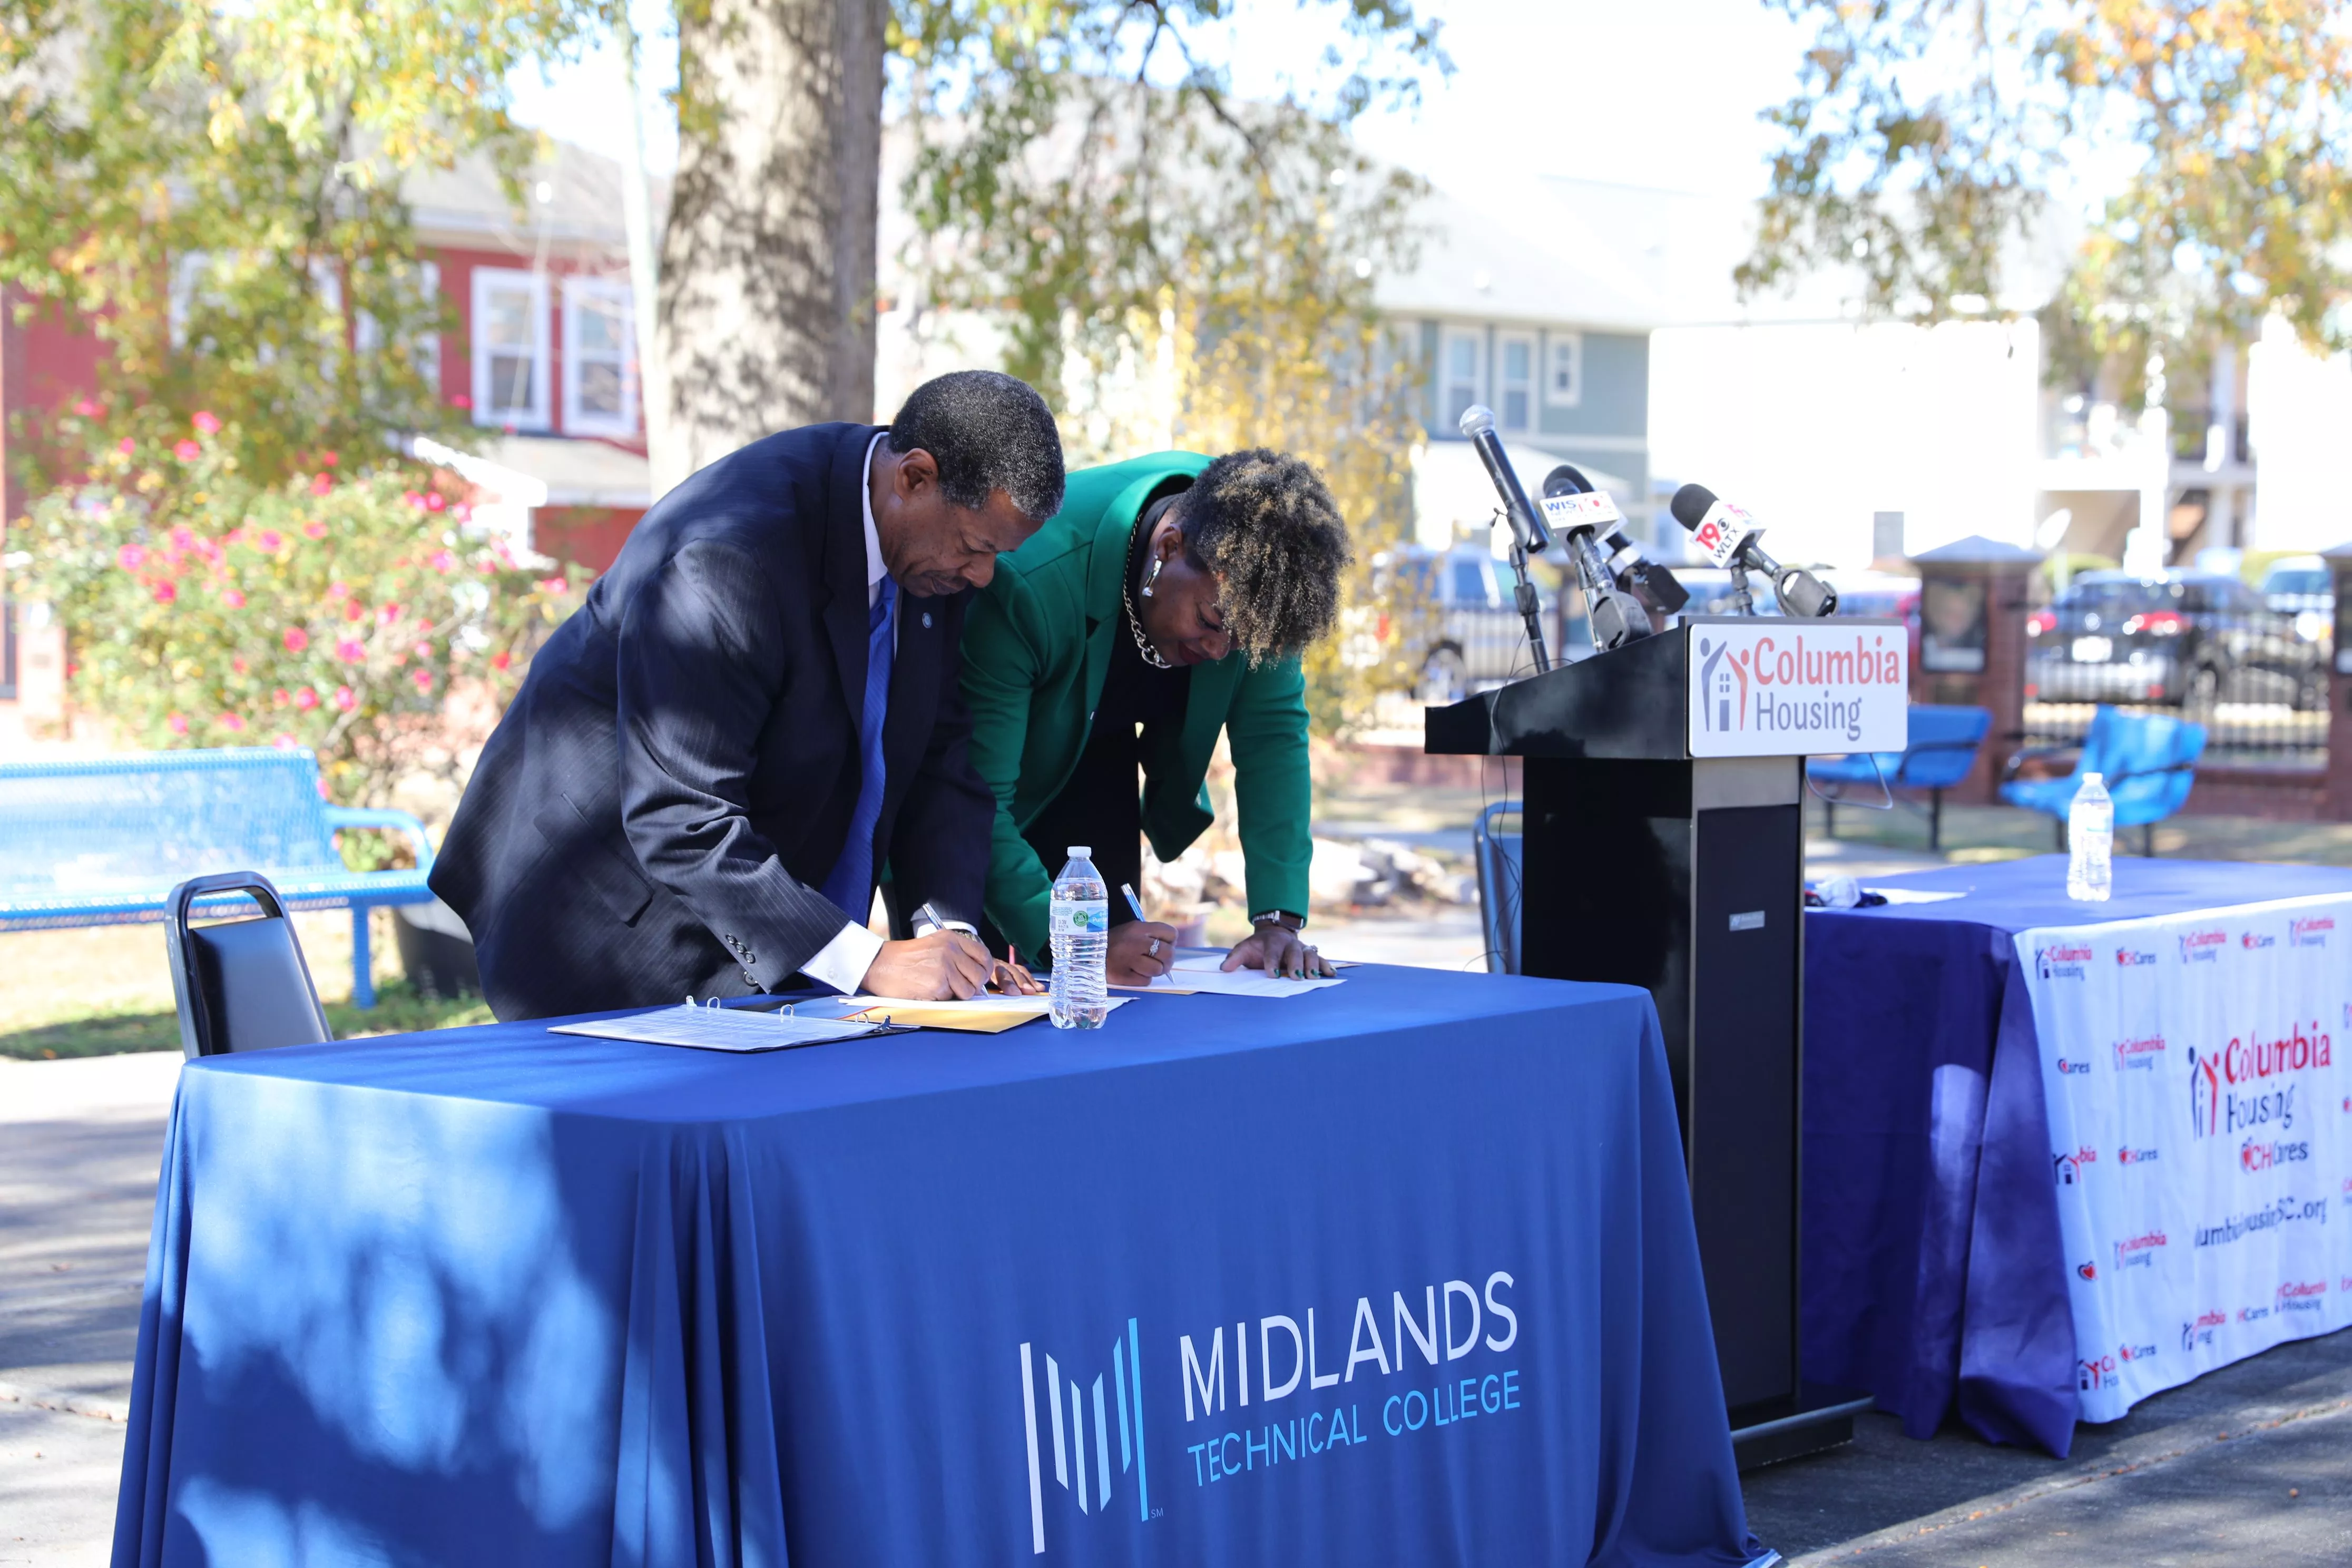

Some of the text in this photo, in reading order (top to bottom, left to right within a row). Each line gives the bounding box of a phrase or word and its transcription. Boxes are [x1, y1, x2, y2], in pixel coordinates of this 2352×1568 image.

[1545, 499, 1576, 511] WIS
[1695, 522, 1721, 551] 19
[1713, 527, 1740, 558] WLTX
[1754, 635, 1900, 685] Columbia
[1756, 690, 1863, 741] Housing
[2224, 1021, 2331, 1085] Columbia
[1180, 1271, 1518, 1422] MIDLANDS
[1188, 1370, 1521, 1486] TECHNICAL COLLEGE
[1151, 1507, 1164, 1518] SM
